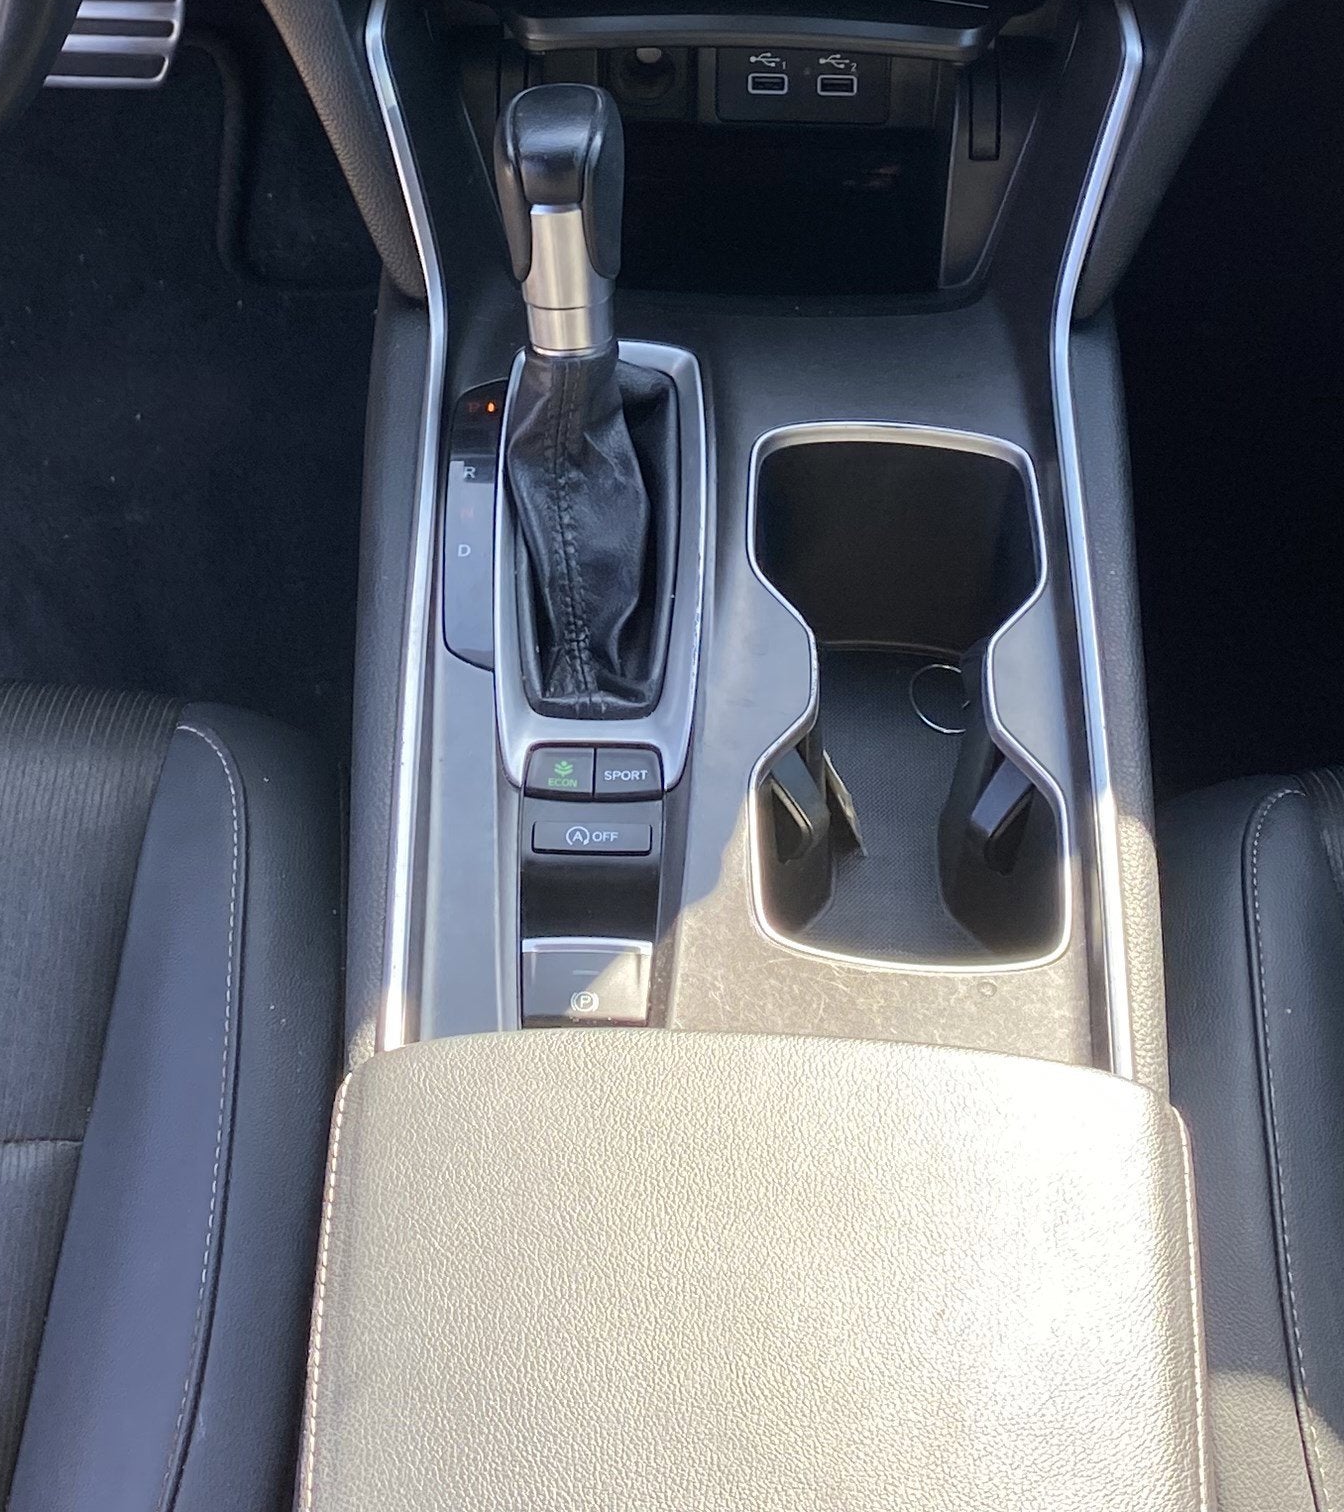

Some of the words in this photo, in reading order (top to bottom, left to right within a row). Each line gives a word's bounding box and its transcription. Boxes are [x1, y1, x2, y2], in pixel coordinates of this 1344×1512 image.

[463, 466, 476, 479] R
[458, 545, 471, 557] D
[604, 770, 648, 781] SPORT
[548, 778, 578, 788] ECON
[592, 831, 619, 842] OFF
